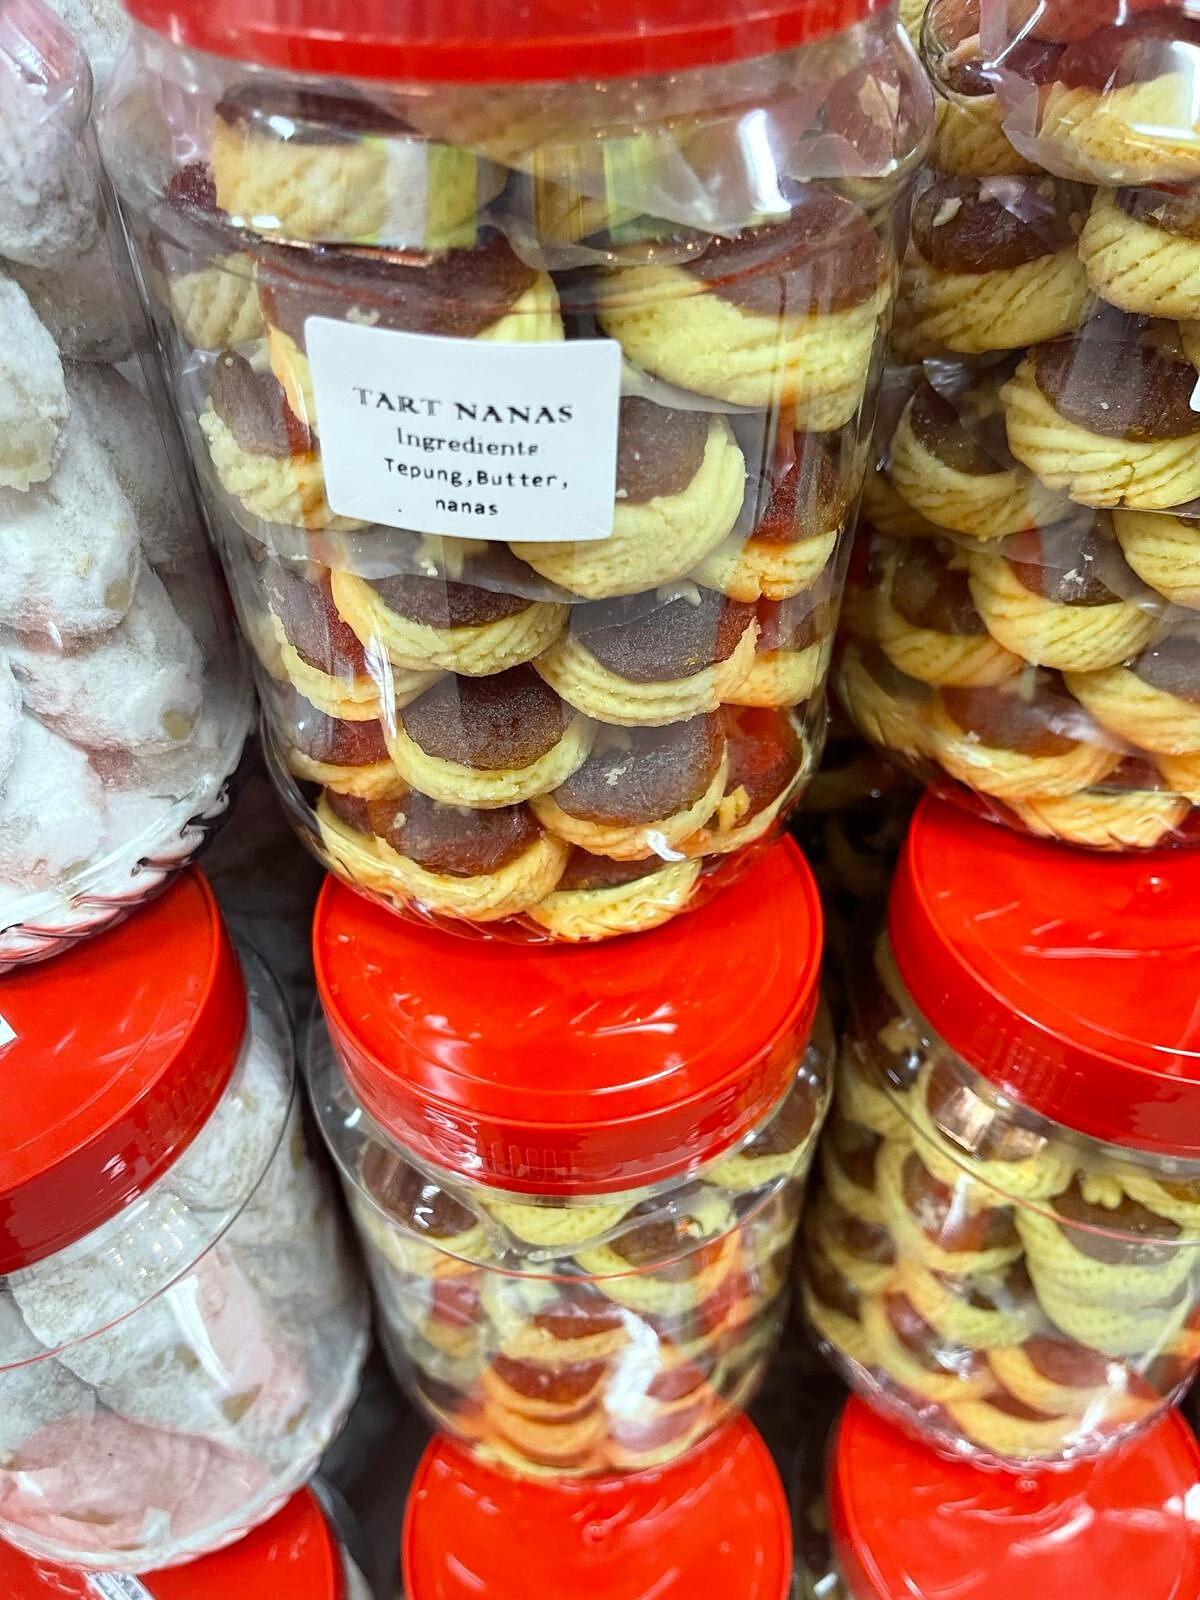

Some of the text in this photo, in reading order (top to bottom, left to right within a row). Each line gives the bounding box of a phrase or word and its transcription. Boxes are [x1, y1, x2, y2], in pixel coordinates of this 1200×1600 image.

[352, 386, 574, 425] TART NANAS
[435, 499, 500, 516] nanas
